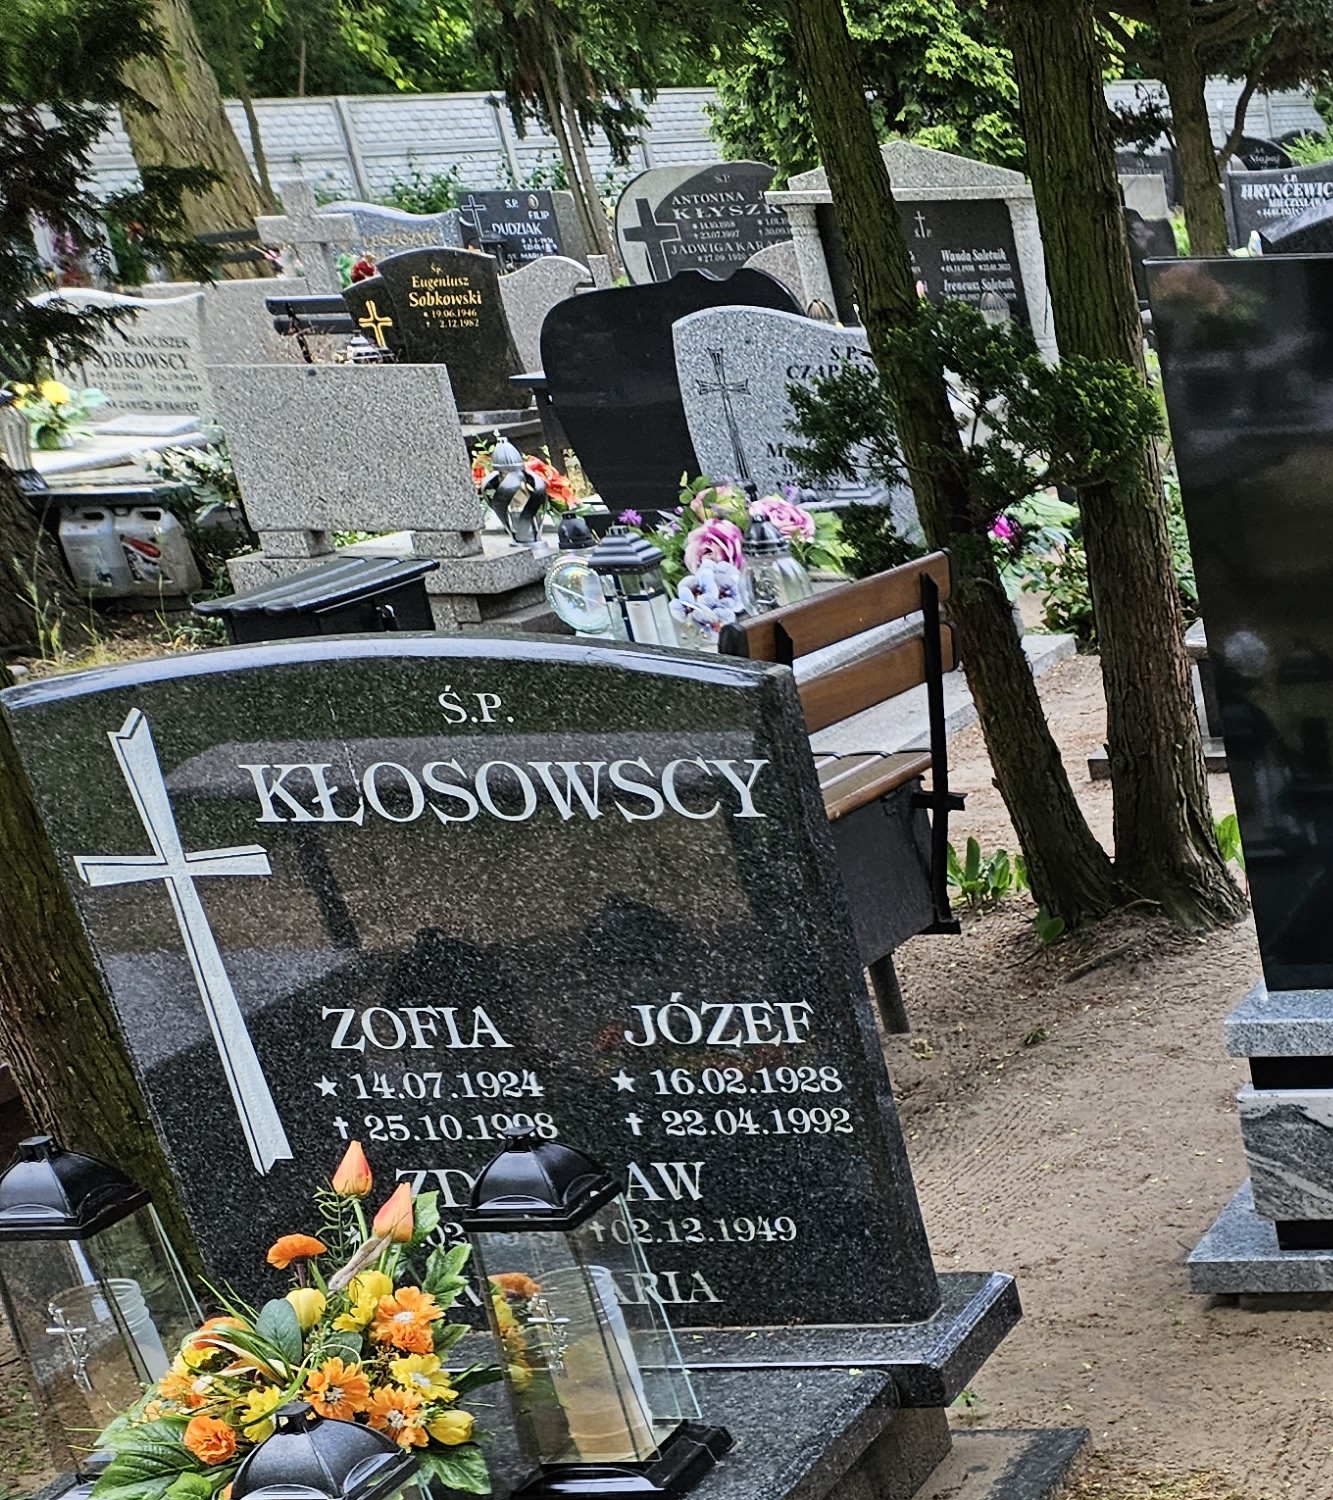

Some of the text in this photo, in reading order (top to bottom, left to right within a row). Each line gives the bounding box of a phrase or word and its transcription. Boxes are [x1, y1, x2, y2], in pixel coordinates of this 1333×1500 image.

[671, 190, 745, 206] ANTONINA
[491, 222, 543, 236] DUDZIAK
[527, 210, 550, 220] FILIP
[671, 240, 734, 256] JADWIGA
[408, 289, 483, 307] Sobkowski
[411, 274, 470, 292] Eugeniusz
[438, 685, 514, 725] Ś.P.
[238, 756, 770, 826] KŁOSOWSCY
[321, 1004, 515, 1053] ZOFIA
[623, 991, 815, 1048] JÓZEF
[350, 1068, 545, 1100] 14.07.1924
[650, 1066, 843, 1096] 16.02.1928
[661, 1107, 854, 1137] 22.04.1992
